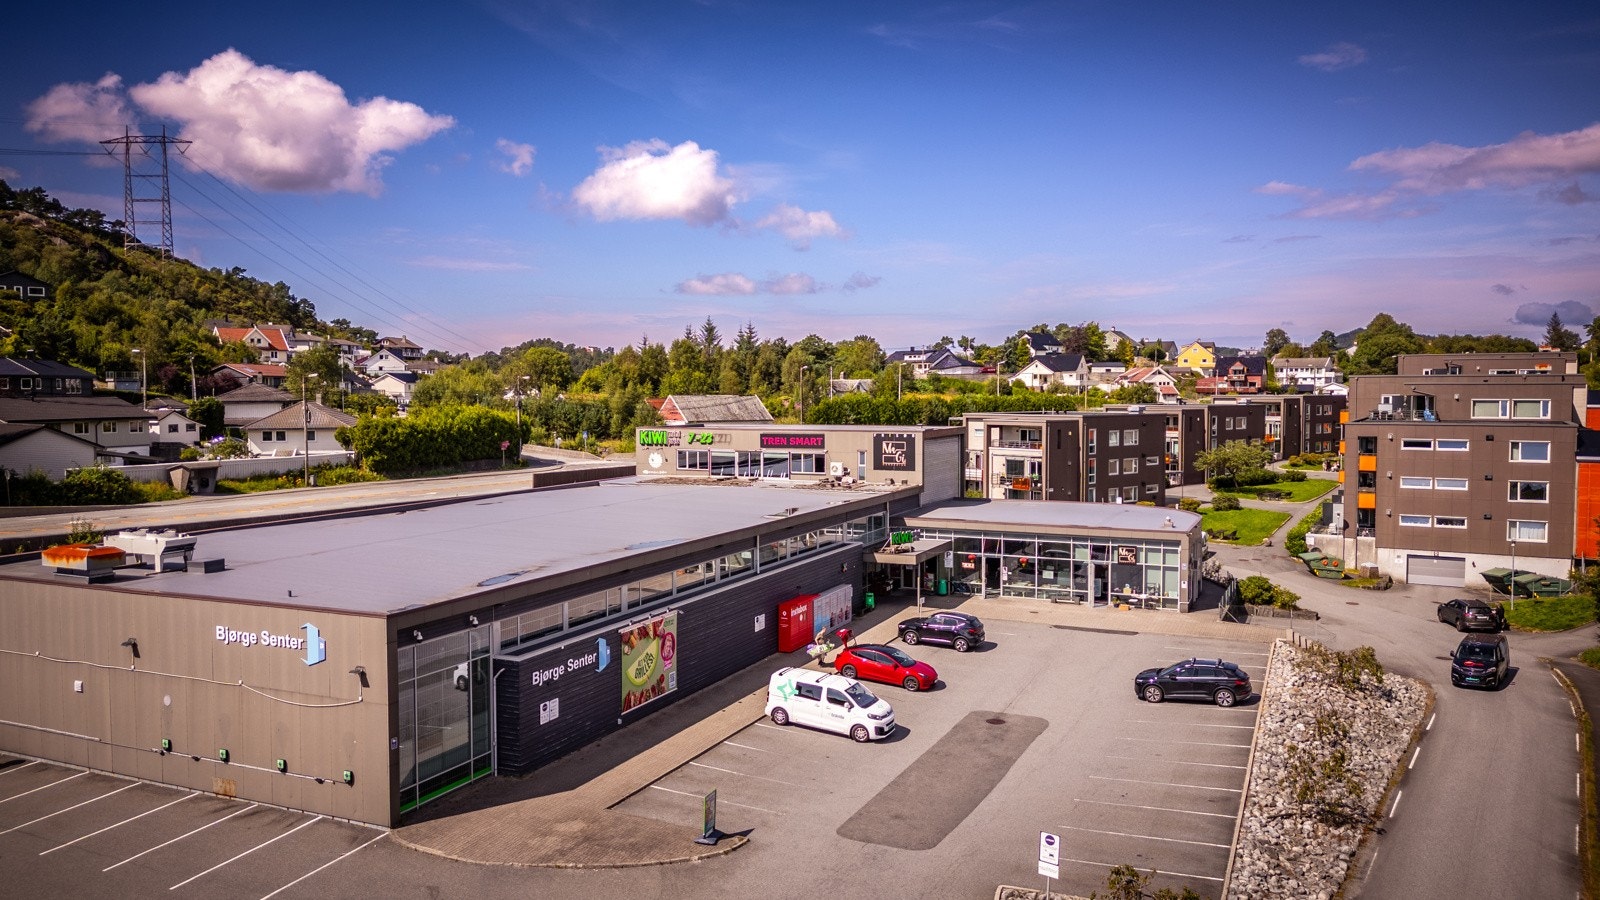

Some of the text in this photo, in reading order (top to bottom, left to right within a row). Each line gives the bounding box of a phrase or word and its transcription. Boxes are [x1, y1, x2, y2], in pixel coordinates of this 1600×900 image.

[640, 430, 667, 446] KIWI
[688, 432, 713, 445] 7-23
[762, 436, 823, 446] TREN SMART
[891, 530, 913, 545] KIWI
[215, 625, 304, 650] Bjørge Senter
[532, 652, 597, 686] Bjørge Senter
